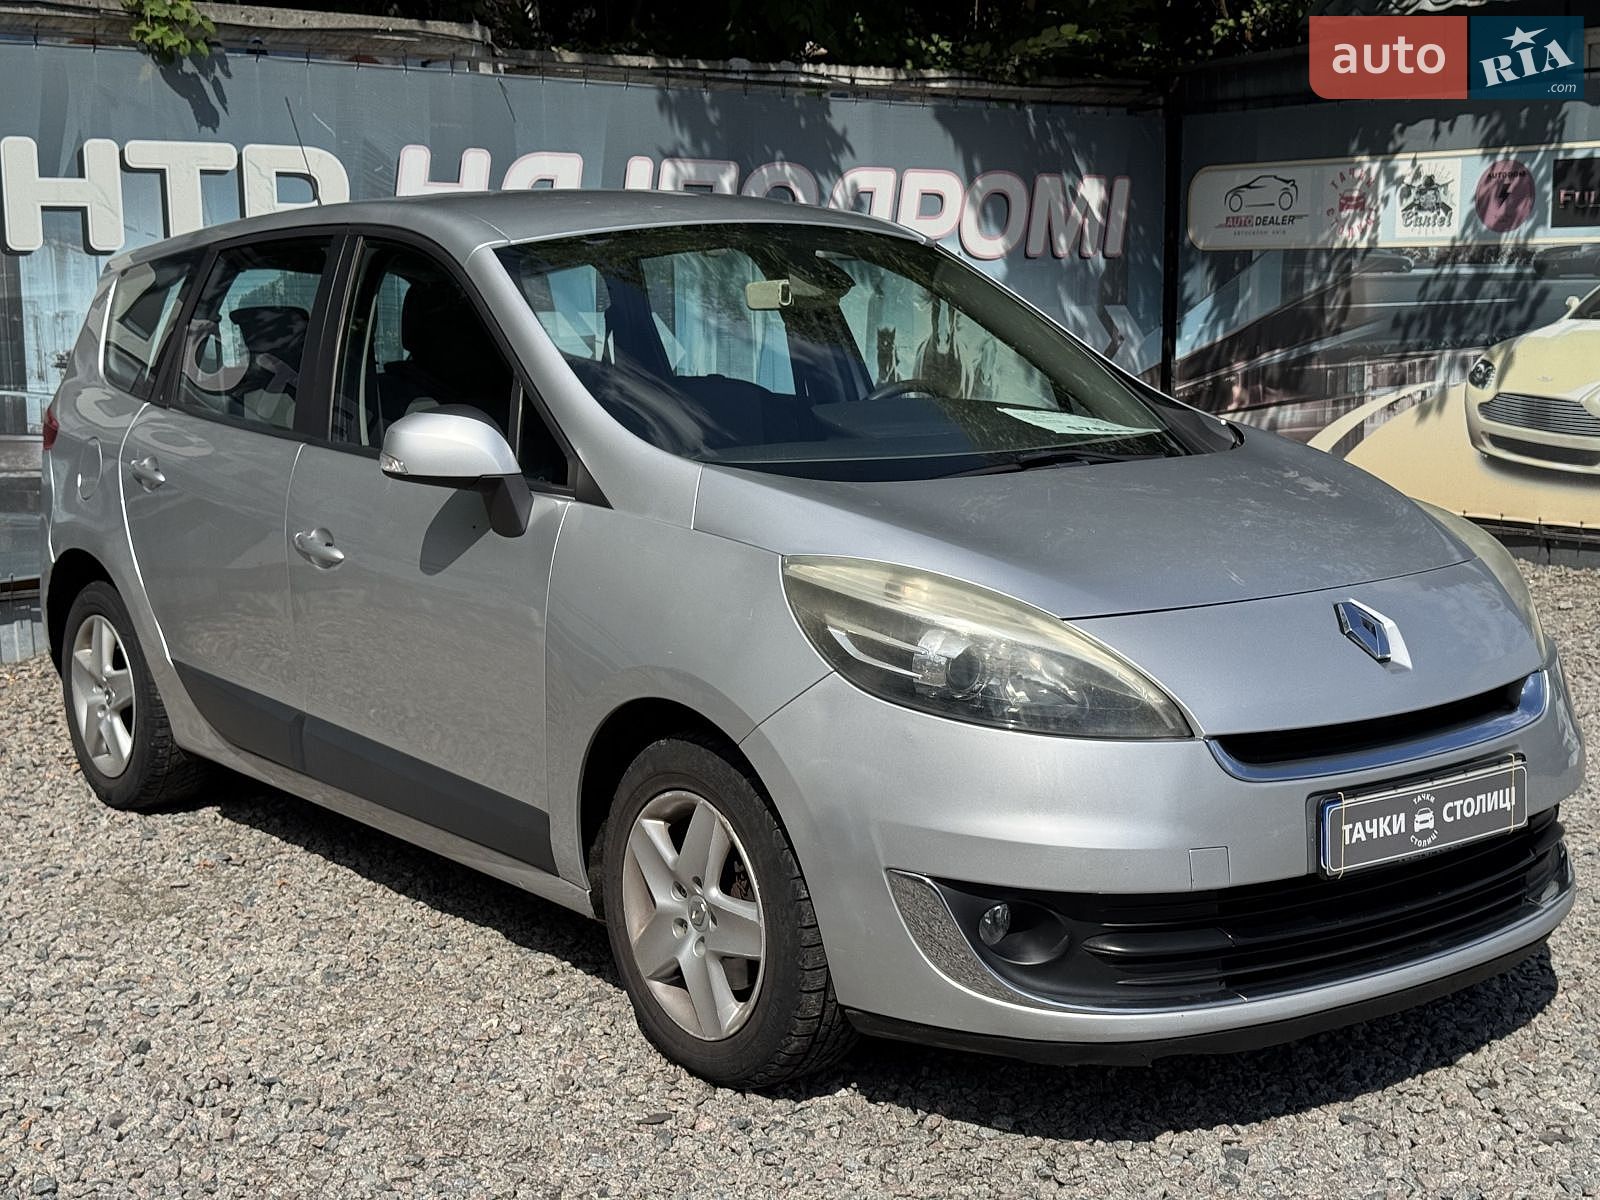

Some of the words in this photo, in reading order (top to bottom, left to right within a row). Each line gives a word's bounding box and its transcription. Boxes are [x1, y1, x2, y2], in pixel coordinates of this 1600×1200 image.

[1255, 215, 1297, 226] DEALER
[1343, 812, 1406, 845] ТАЧКИ
[1442, 785, 1516, 823] СТОЛИЦІ
